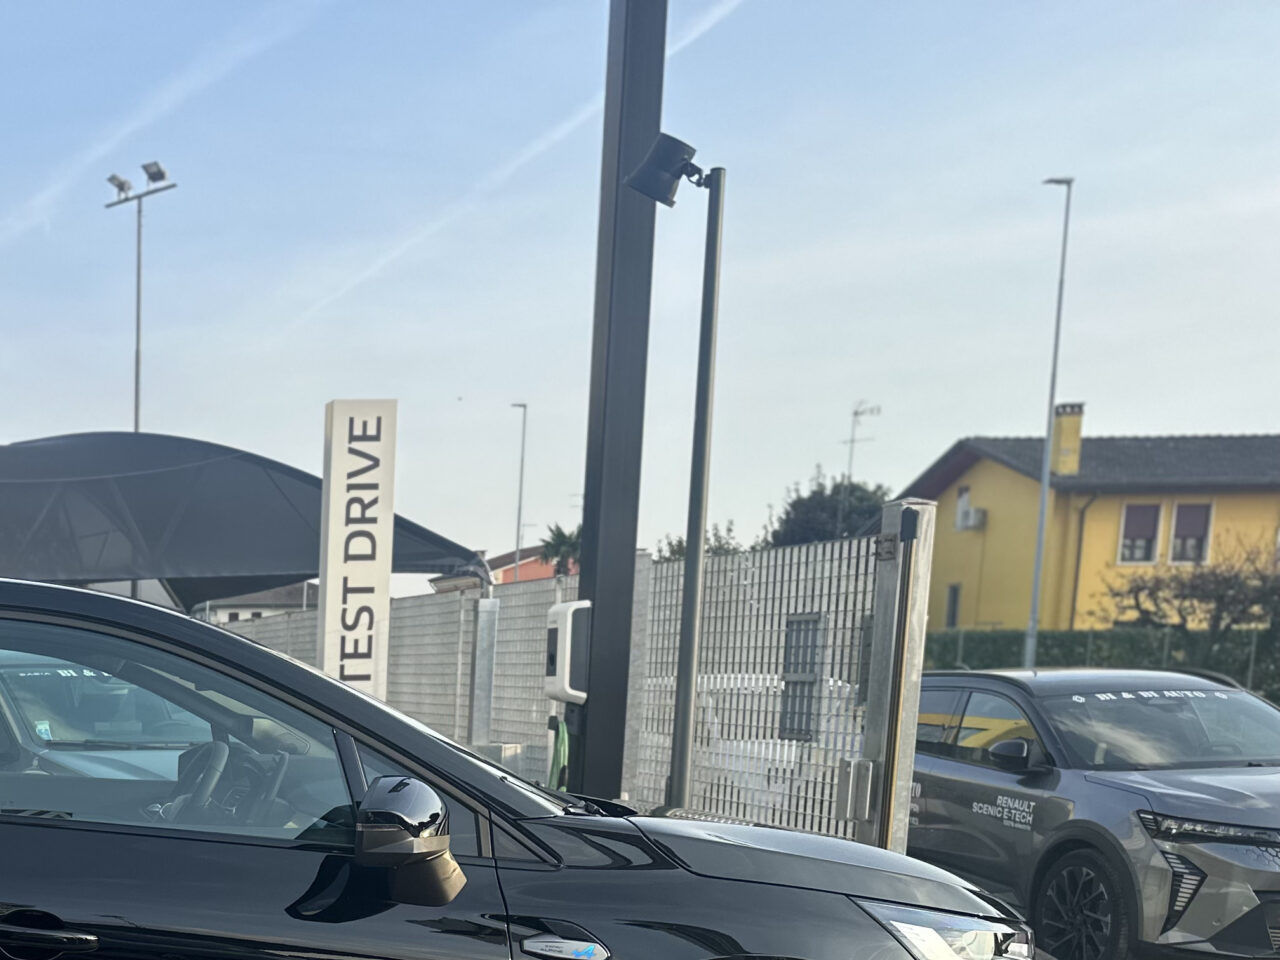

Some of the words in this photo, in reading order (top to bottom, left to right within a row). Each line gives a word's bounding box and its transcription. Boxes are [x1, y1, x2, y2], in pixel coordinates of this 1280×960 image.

[343, 416, 382, 563] DRIVE
[339, 576, 375, 681] TEST
[1163, 690, 1207, 698] AUTO
[972, 802, 1003, 818] SCENIC
[1002, 808, 1034, 825] E-TECH
[997, 795, 1036, 813] RENAULT
